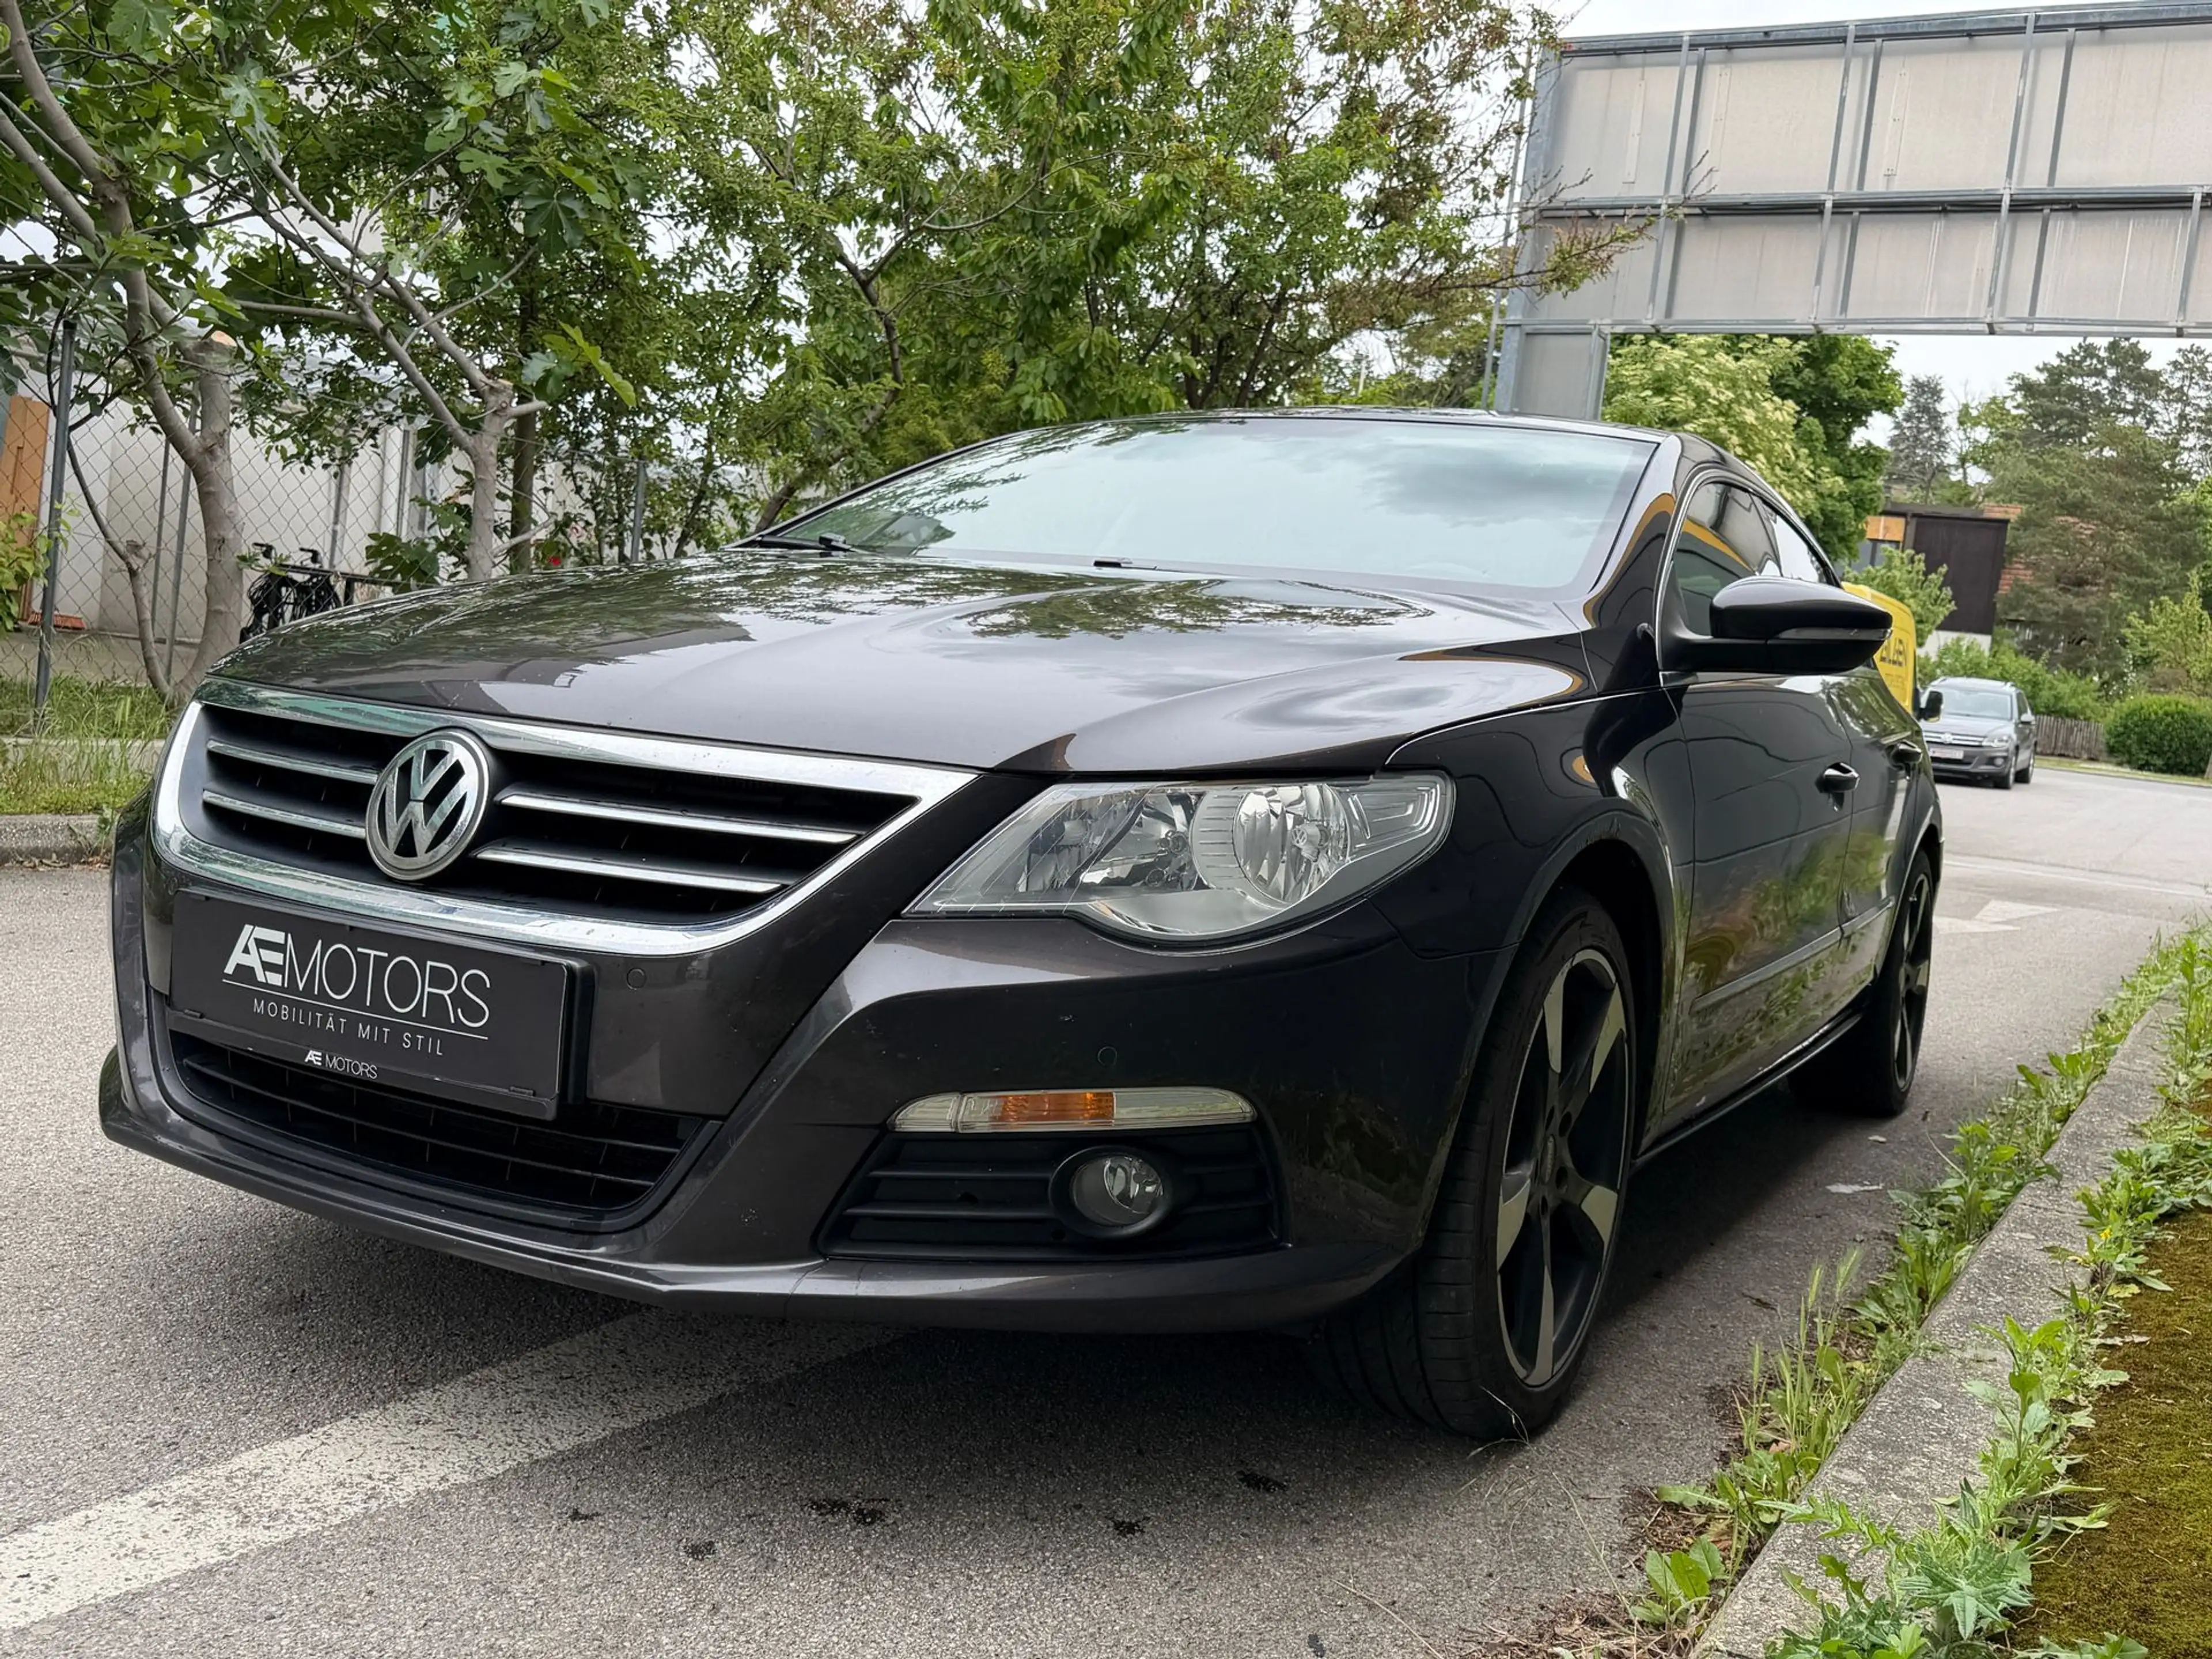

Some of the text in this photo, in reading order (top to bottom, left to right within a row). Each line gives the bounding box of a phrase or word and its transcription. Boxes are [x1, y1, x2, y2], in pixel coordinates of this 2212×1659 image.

[253, 998, 443, 1055] MOBILITÄT MIT STIL
[325, 1054, 378, 1079] MOTORS
